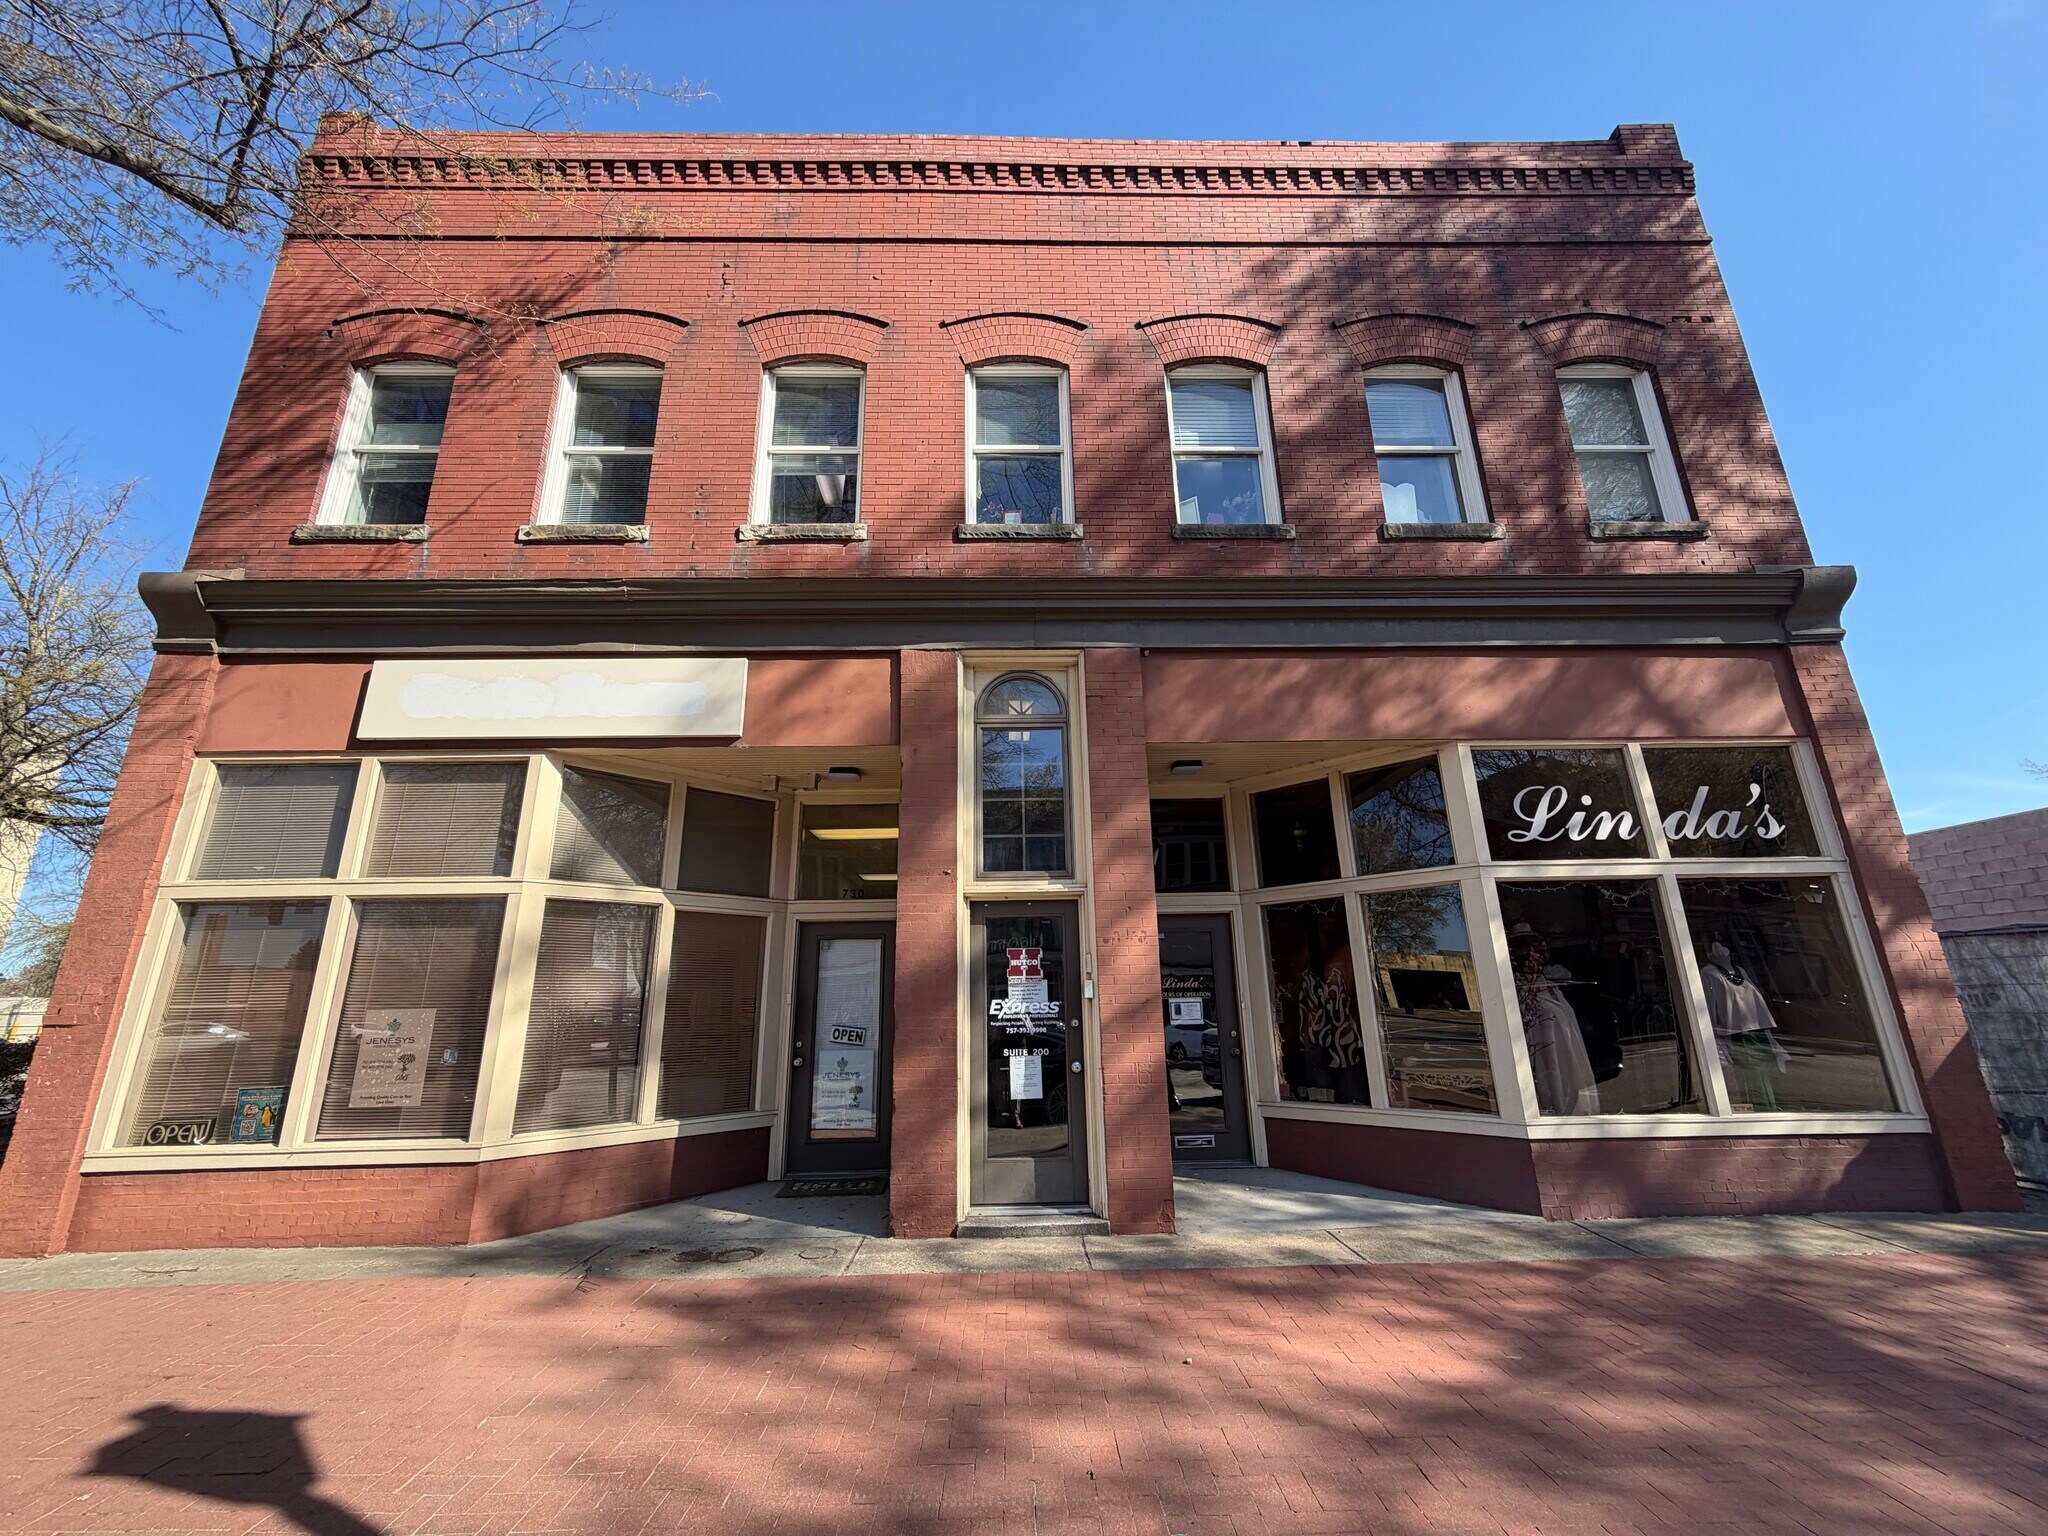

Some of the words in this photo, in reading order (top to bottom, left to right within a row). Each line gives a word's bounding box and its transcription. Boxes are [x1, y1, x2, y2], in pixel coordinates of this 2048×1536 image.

[1507, 783, 1786, 843] Linda's
[842, 889, 865, 899] 730
[365, 1036, 416, 1045] JENESYS
[832, 1028, 864, 1043] OPEN
[1003, 1049, 1029, 1057] SUITE
[1033, 1048, 1050, 1056] 200
[147, 1124, 206, 1144] OPEN
